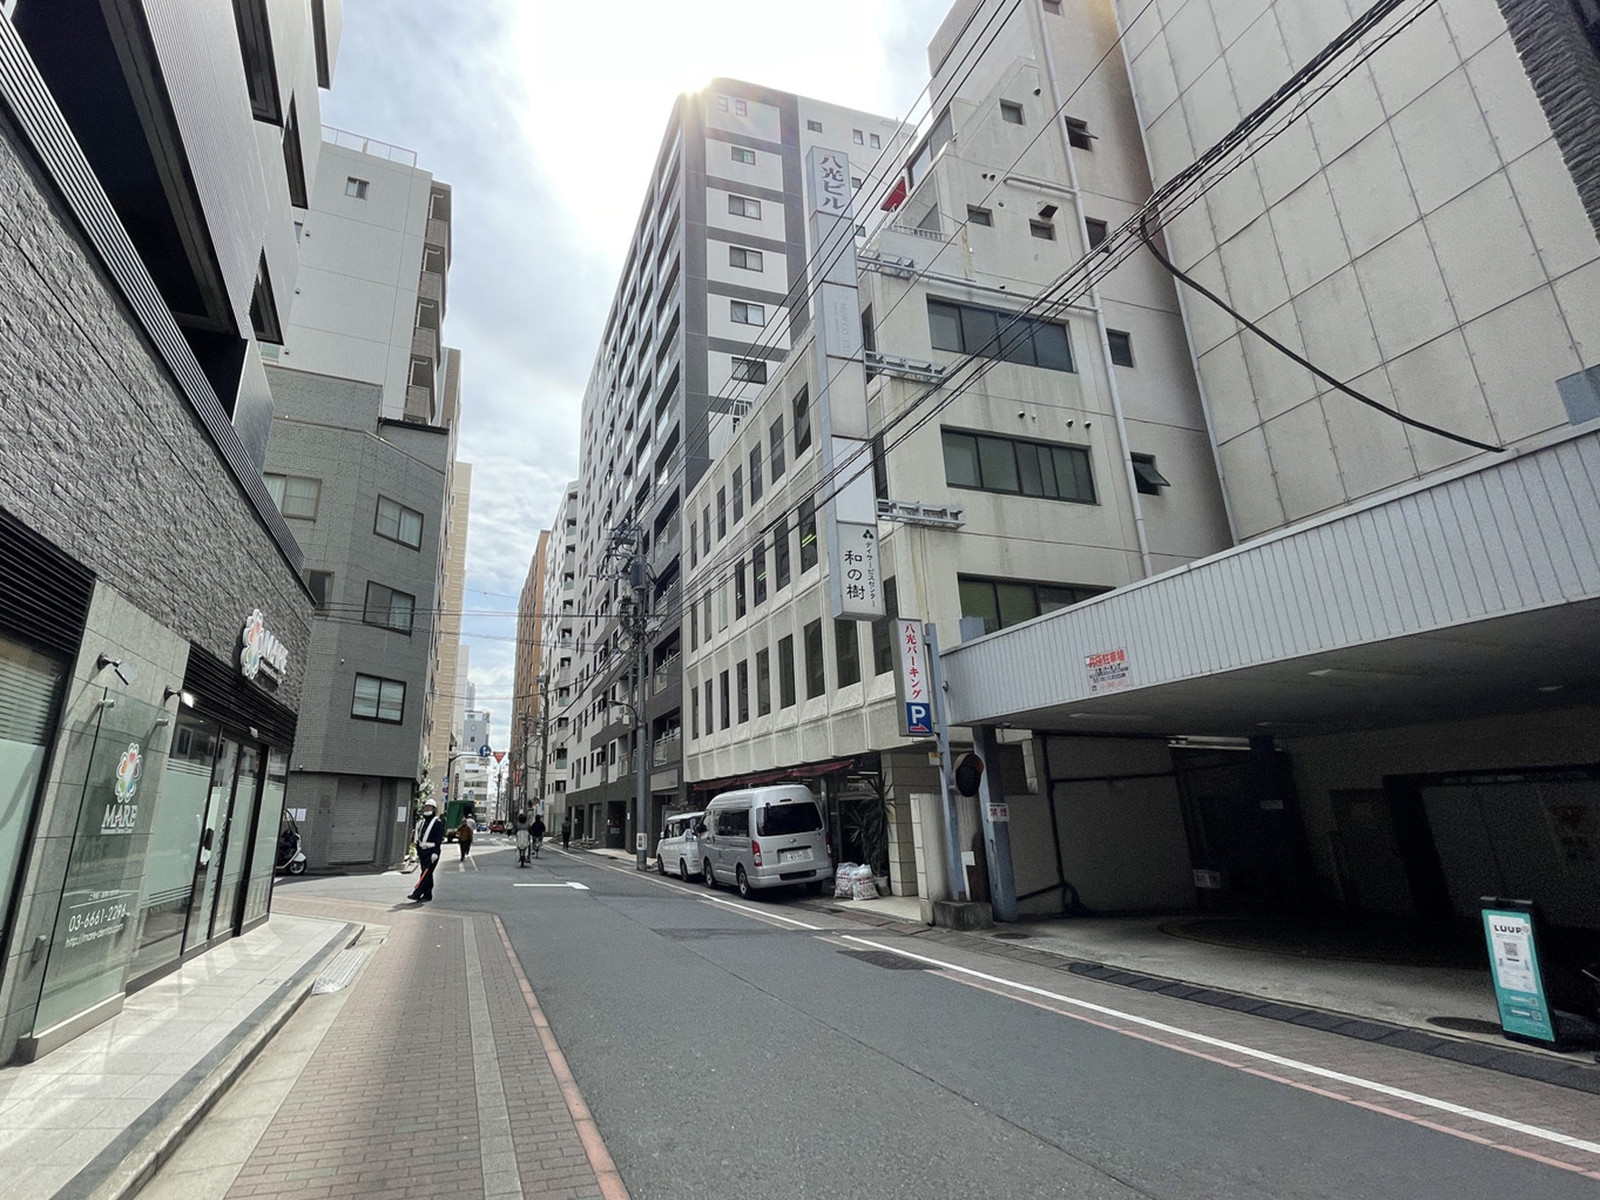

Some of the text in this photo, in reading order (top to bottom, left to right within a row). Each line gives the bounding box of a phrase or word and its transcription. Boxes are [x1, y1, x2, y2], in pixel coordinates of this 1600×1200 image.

[820, 154, 845, 210] 八光ビル
[844, 549, 865, 600] 和の樹
[865, 541, 876, 607] デイサービスセンター
[905, 623, 922, 699] 八光パーキング
[911, 705, 926, 724] P
[101, 804, 138, 828] MARE
